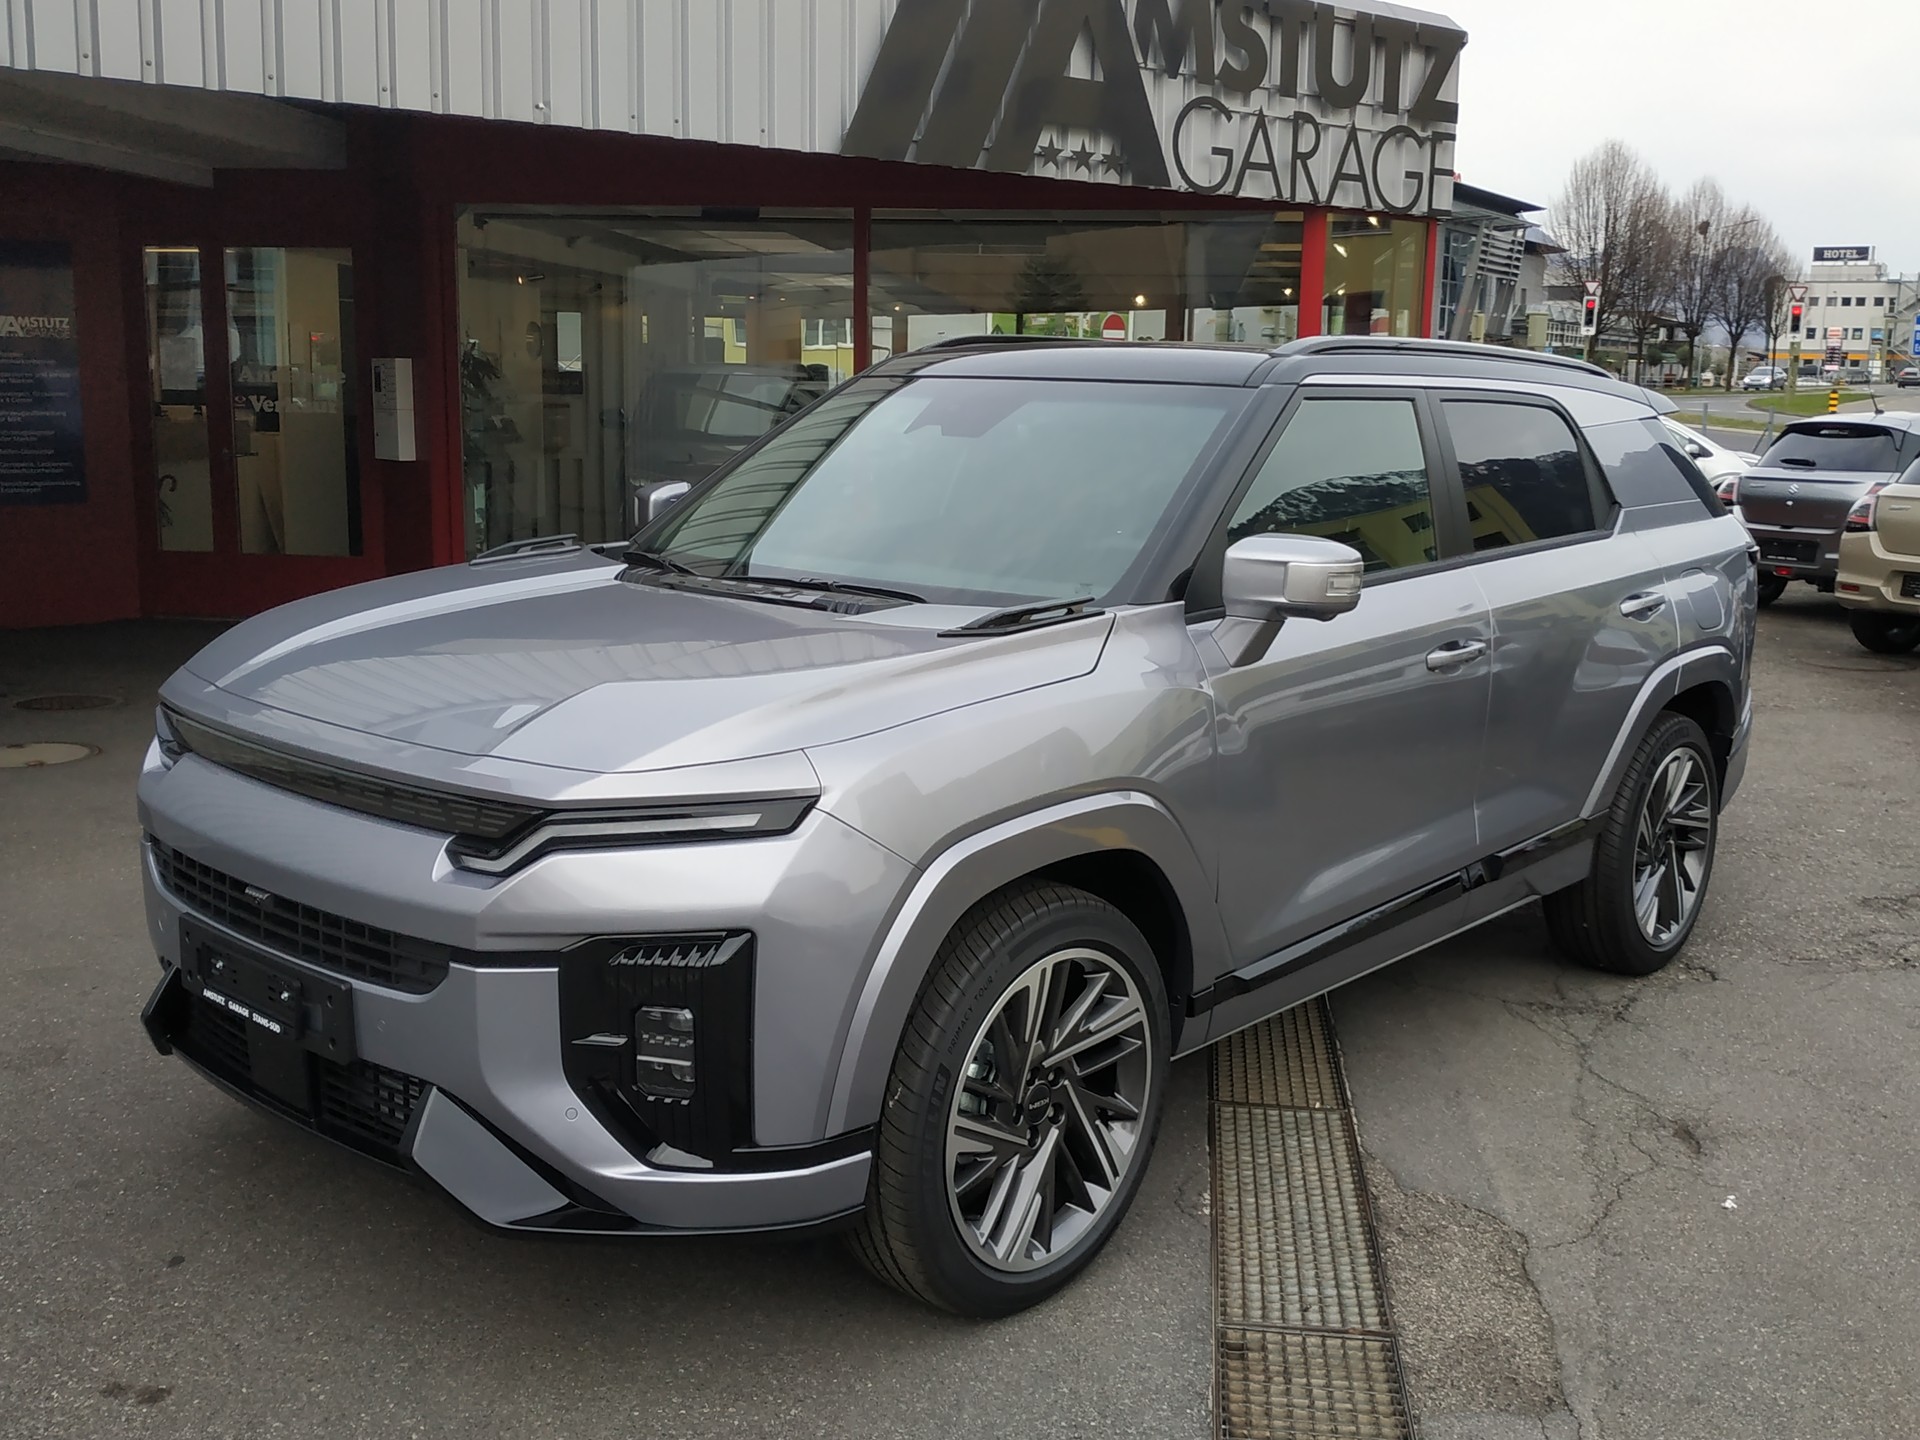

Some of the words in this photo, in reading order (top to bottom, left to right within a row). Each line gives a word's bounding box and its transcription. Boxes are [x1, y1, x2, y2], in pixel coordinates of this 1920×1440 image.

[1172, 96, 1457, 216] GARAGE
[1823, 249, 1859, 259] HOTEL
[228, 1001, 249, 1017] GARAGE
[947, 1006, 973, 1055] PRIMACY
[975, 976, 993, 1000] TOUR
[1029, 1097, 1050, 1110] KGM
